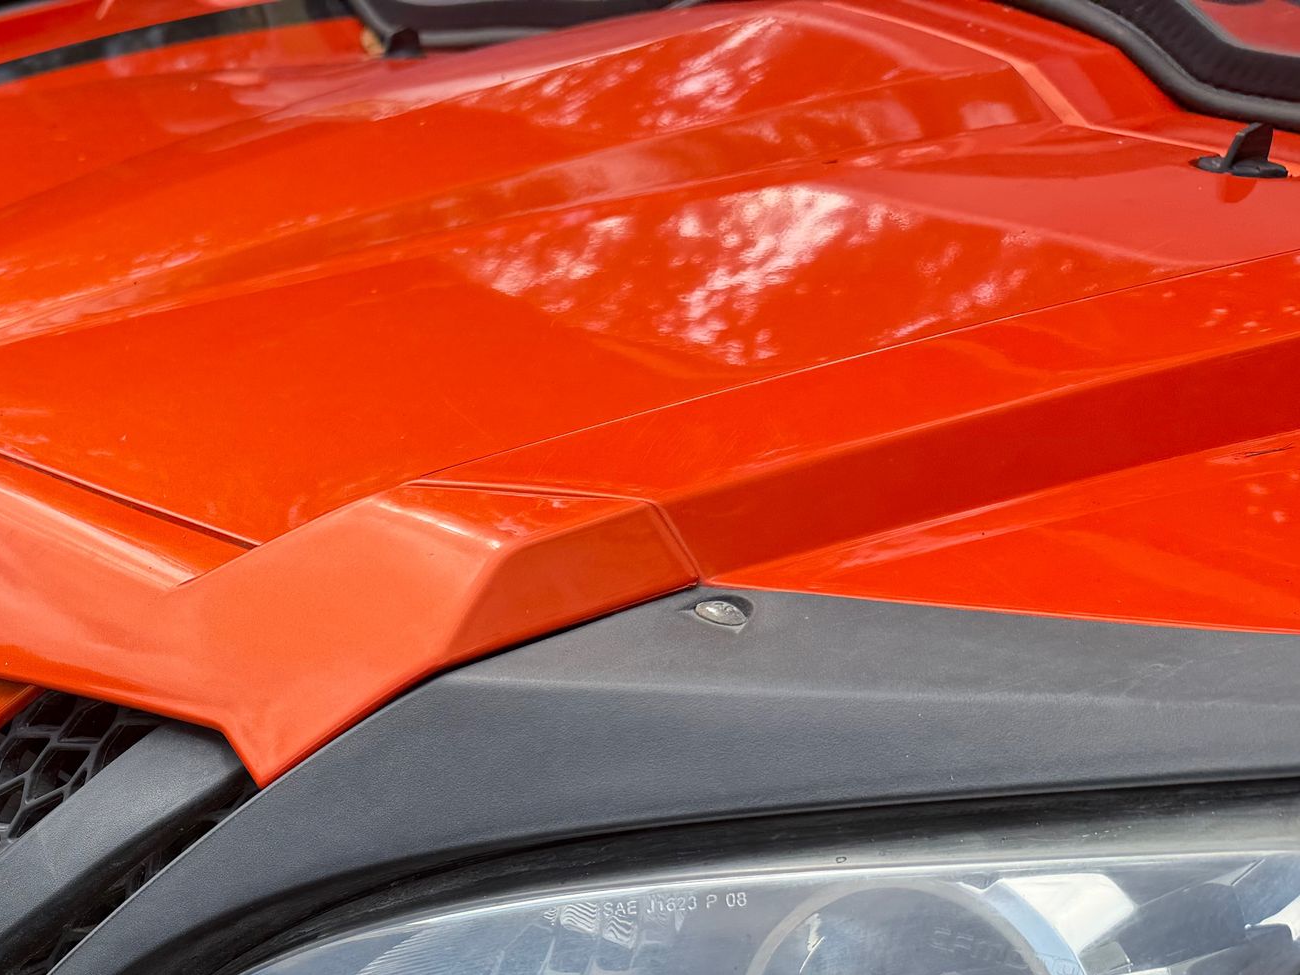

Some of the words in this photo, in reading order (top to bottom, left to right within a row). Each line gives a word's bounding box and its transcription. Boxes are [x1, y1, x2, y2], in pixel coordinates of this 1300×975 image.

[602, 900, 638, 917] SAE
[646, 895, 698, 914] J1623
[705, 893, 718, 909] P
[724, 891, 749, 909] 08
